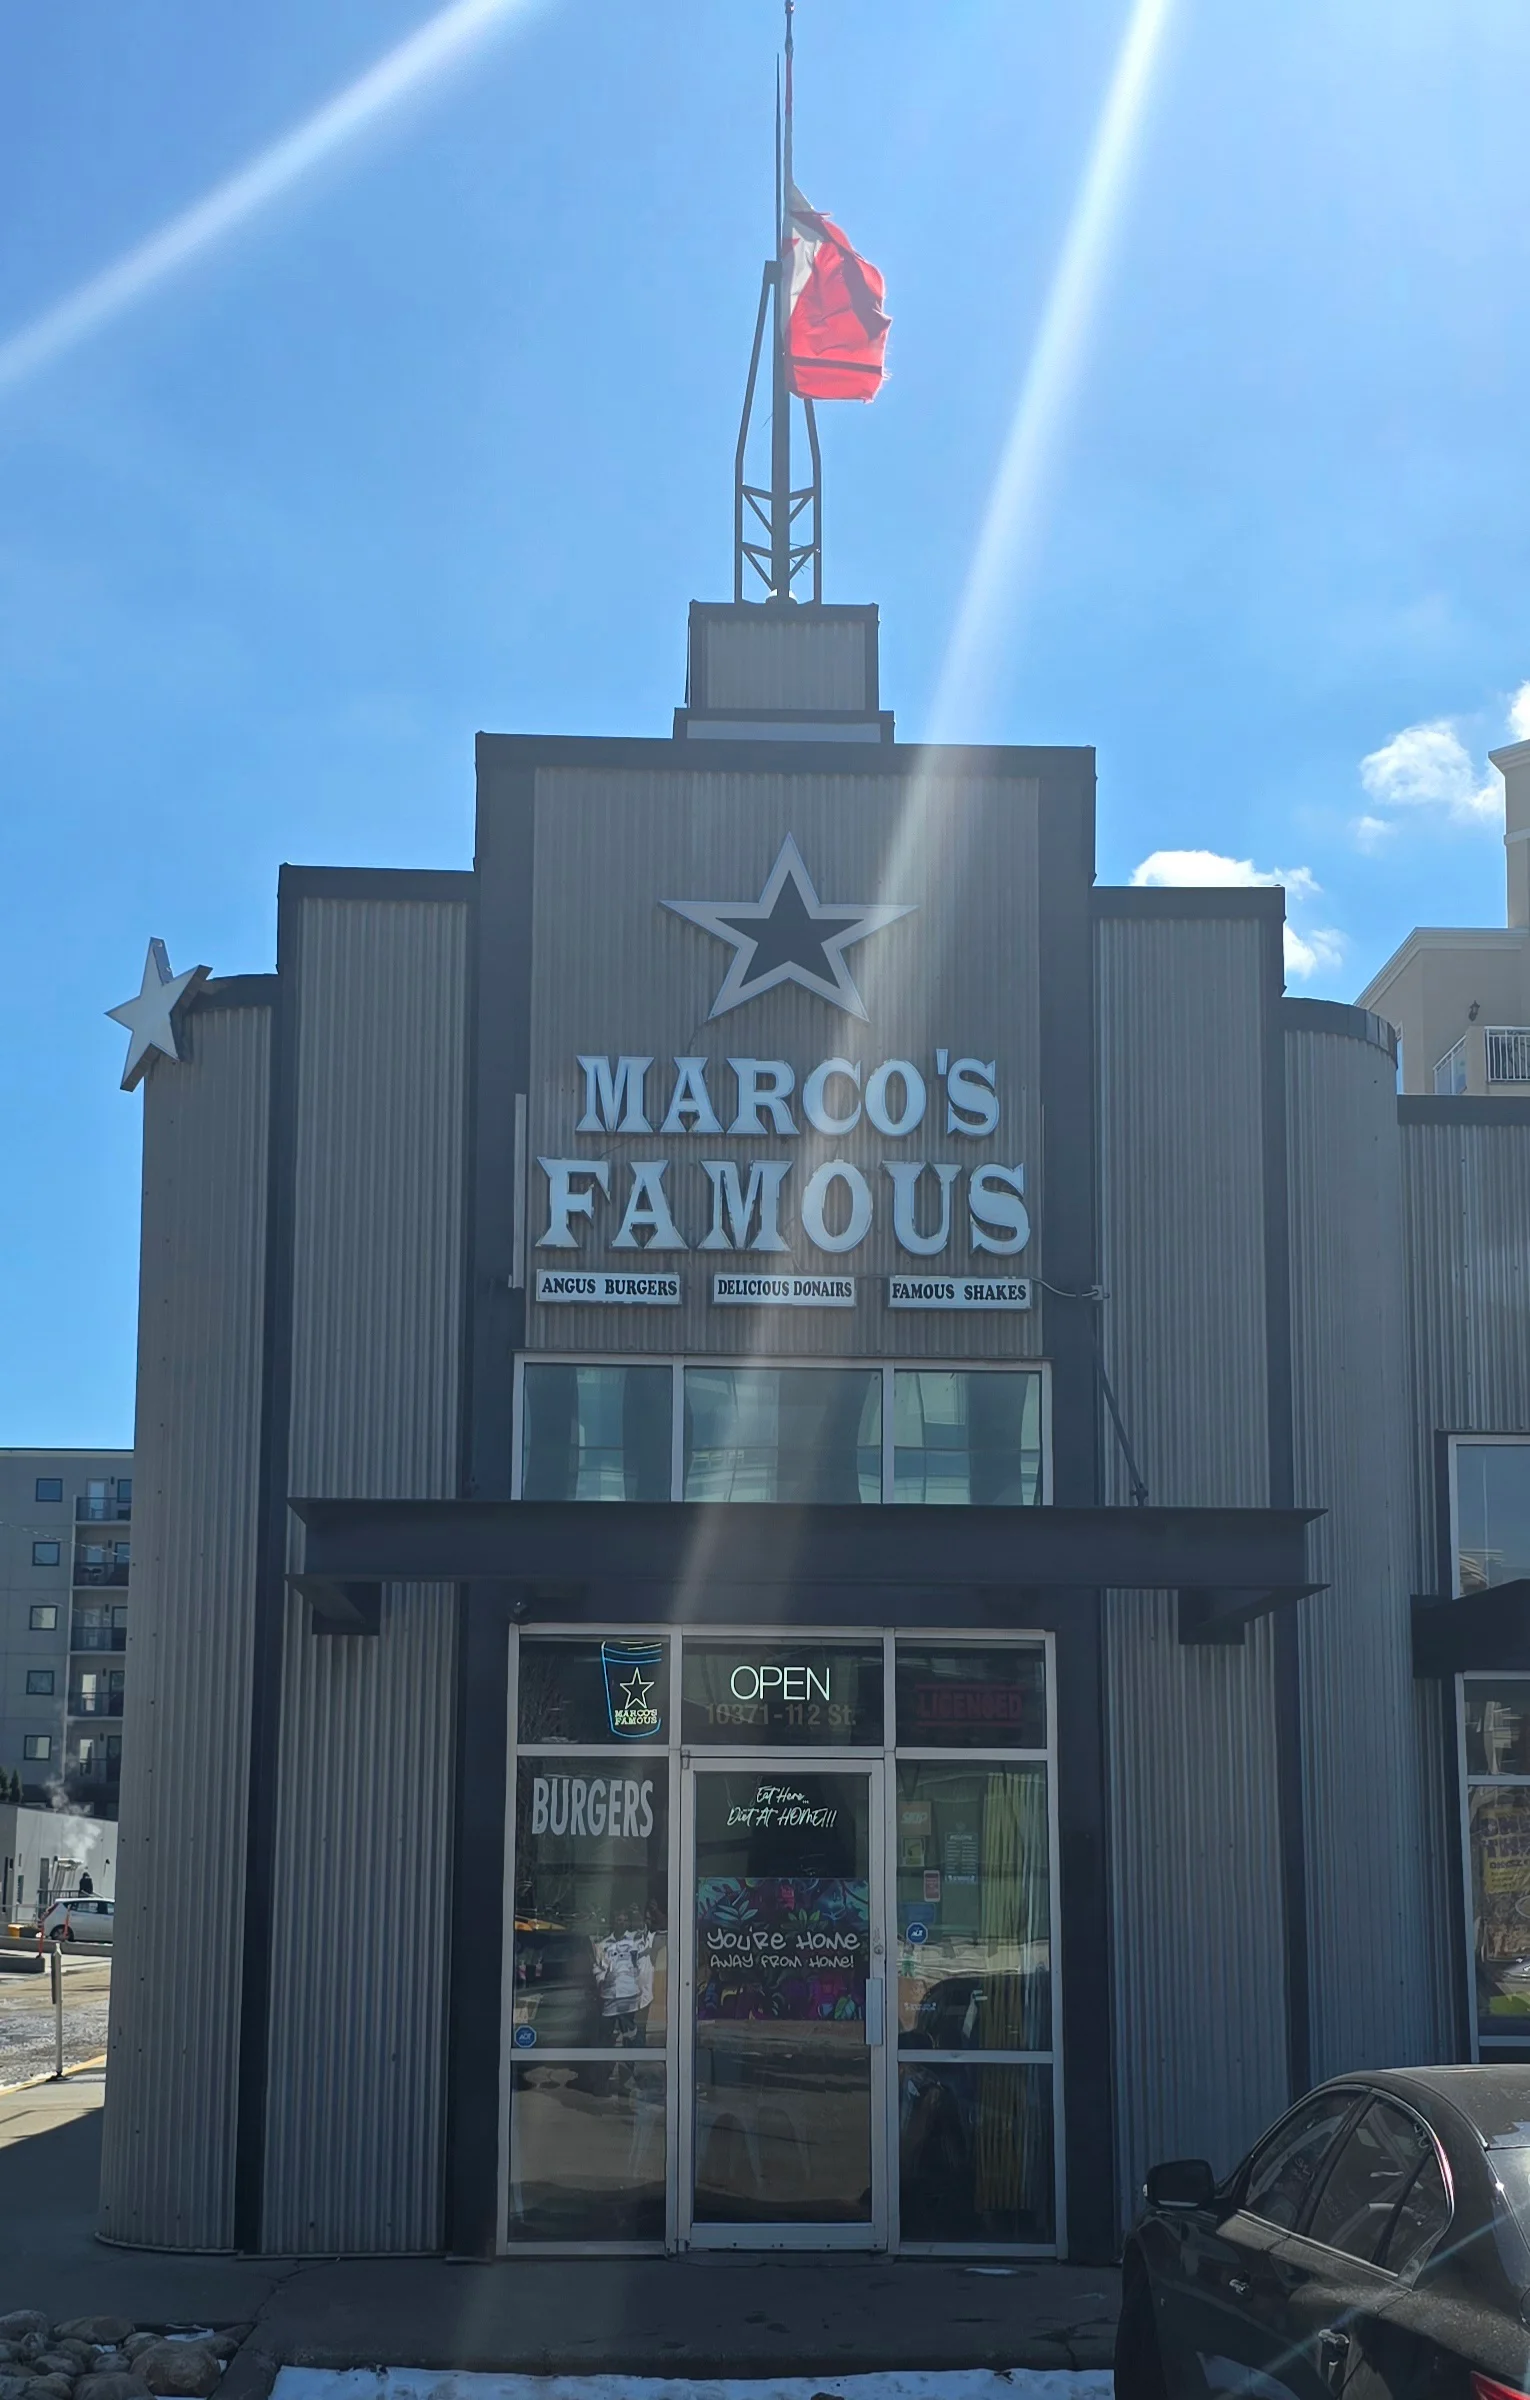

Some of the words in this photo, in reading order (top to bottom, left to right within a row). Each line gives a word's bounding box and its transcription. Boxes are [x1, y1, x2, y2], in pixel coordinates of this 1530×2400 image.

[575, 1048, 1001, 1136] MARCO'S
[535, 1157, 1031, 1255] FAMOUS
[541, 1276, 596, 1295] ANGUS
[604, 1278, 678, 1296] BURGERS
[717, 1279, 789, 1297] DELICIOUS
[793, 1280, 852, 1298] DONAIRS
[892, 1282, 955, 1300] FAMOUS
[963, 1283, 1027, 1300] SHAKES
[730, 1665, 830, 1701] OPEN
[614, 1716, 658, 1726] FAMOUS
[828, 1704, 857, 1725] St.
[756, 1785, 778, 1804] Eat
[532, 1777, 654, 1838] BURGERS
[727, 1807, 758, 1827] Diet
[710, 1953, 754, 1969] AWAY
